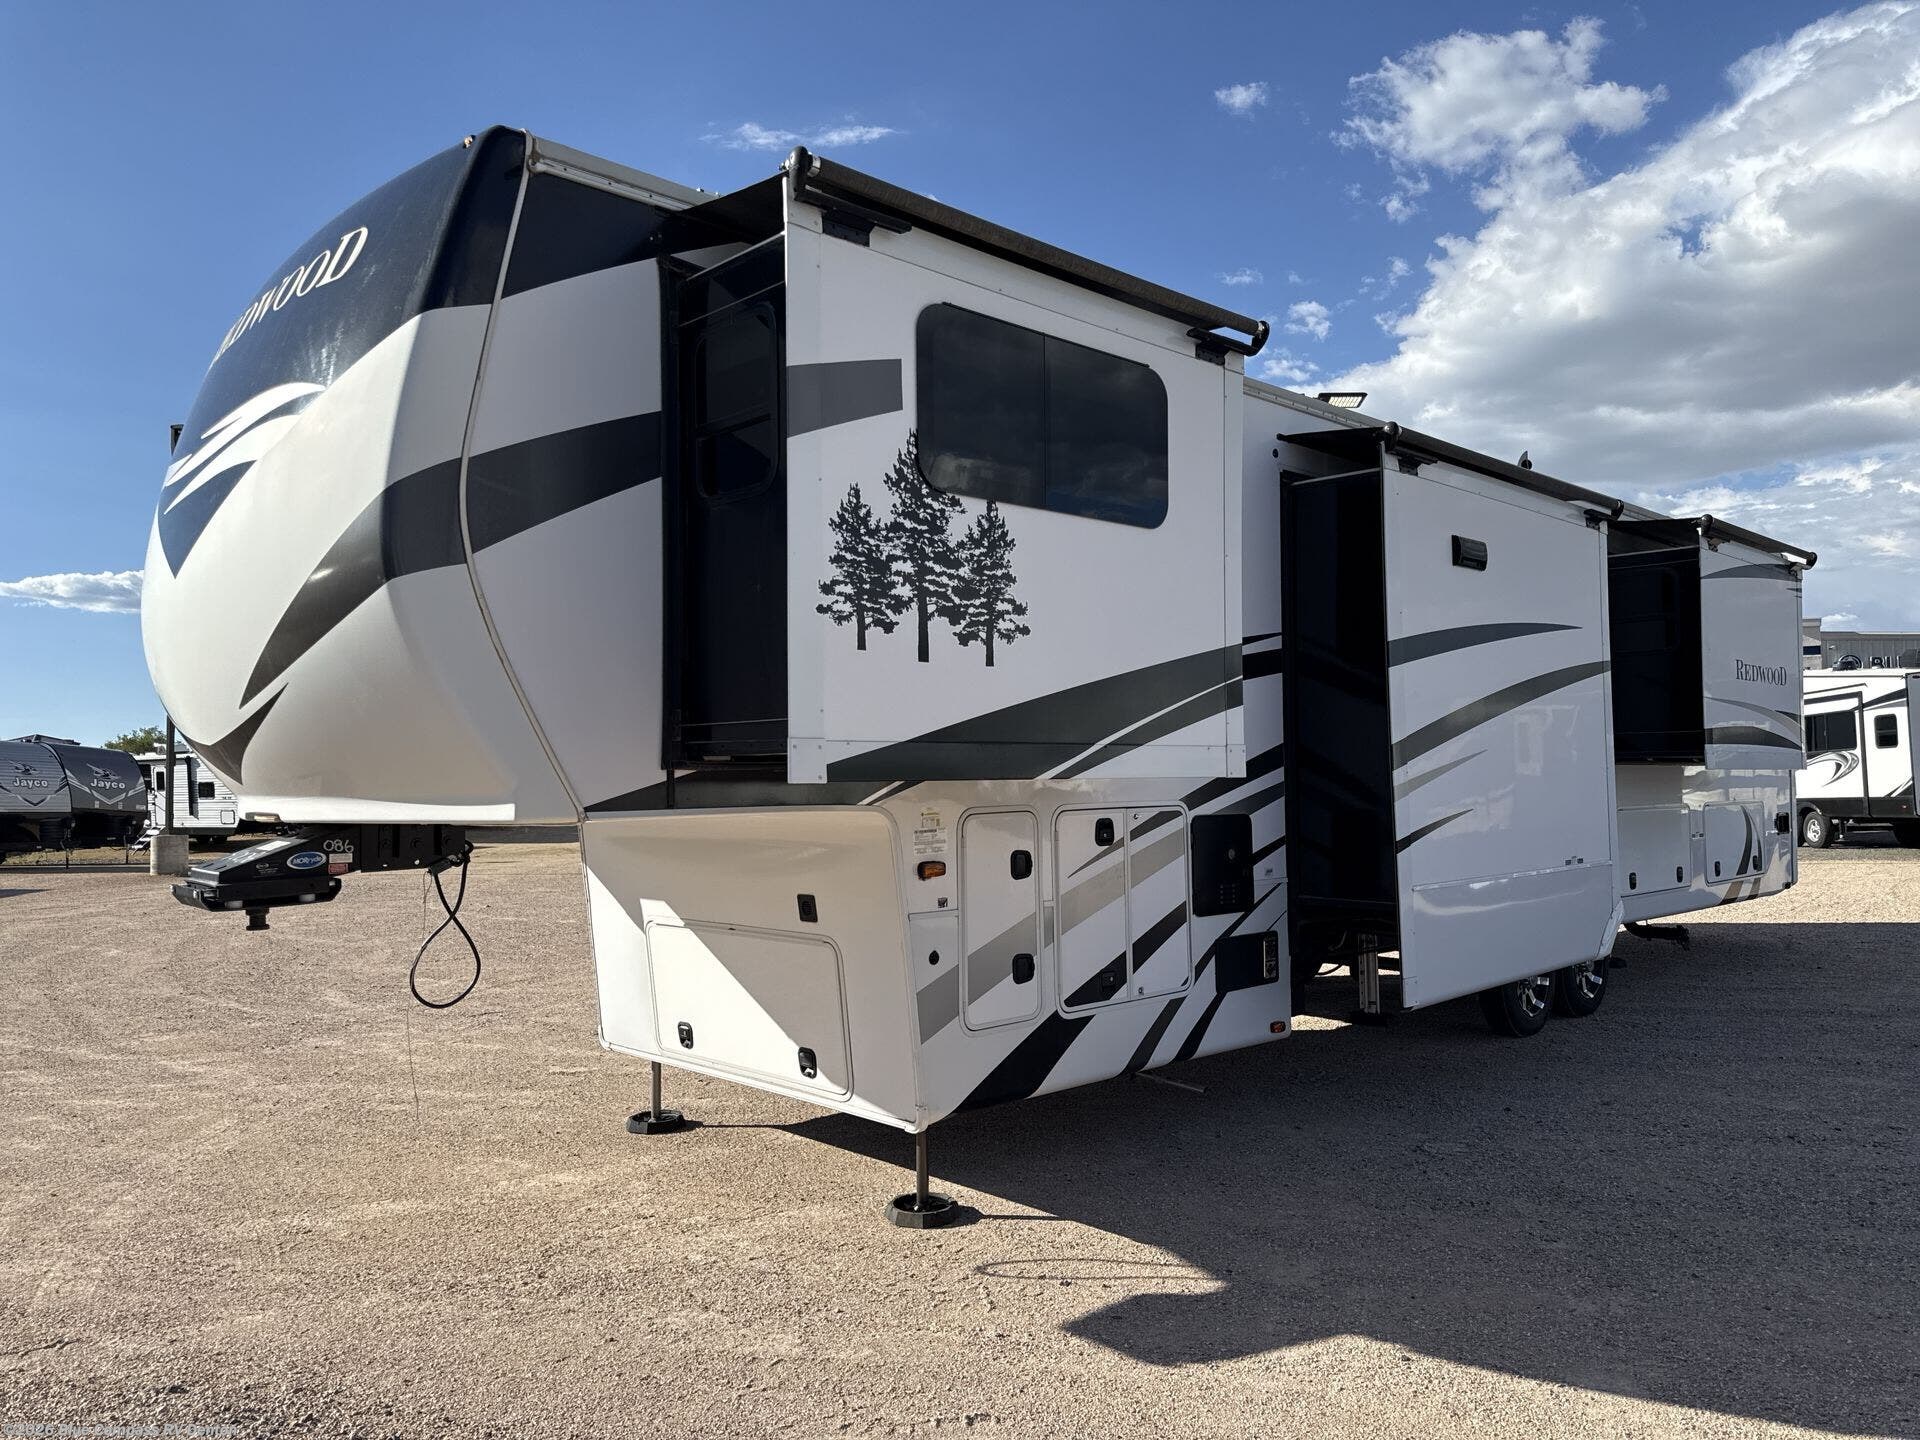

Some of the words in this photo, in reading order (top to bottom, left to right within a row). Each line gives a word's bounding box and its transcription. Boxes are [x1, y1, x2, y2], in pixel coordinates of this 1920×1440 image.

[205, 226, 368, 373] DWOOD
[1735, 659, 1787, 687] REDWOOD
[13, 777, 49, 789] Jayco
[90, 778, 126, 790] Jayco
[323, 839, 354, 853] 086
